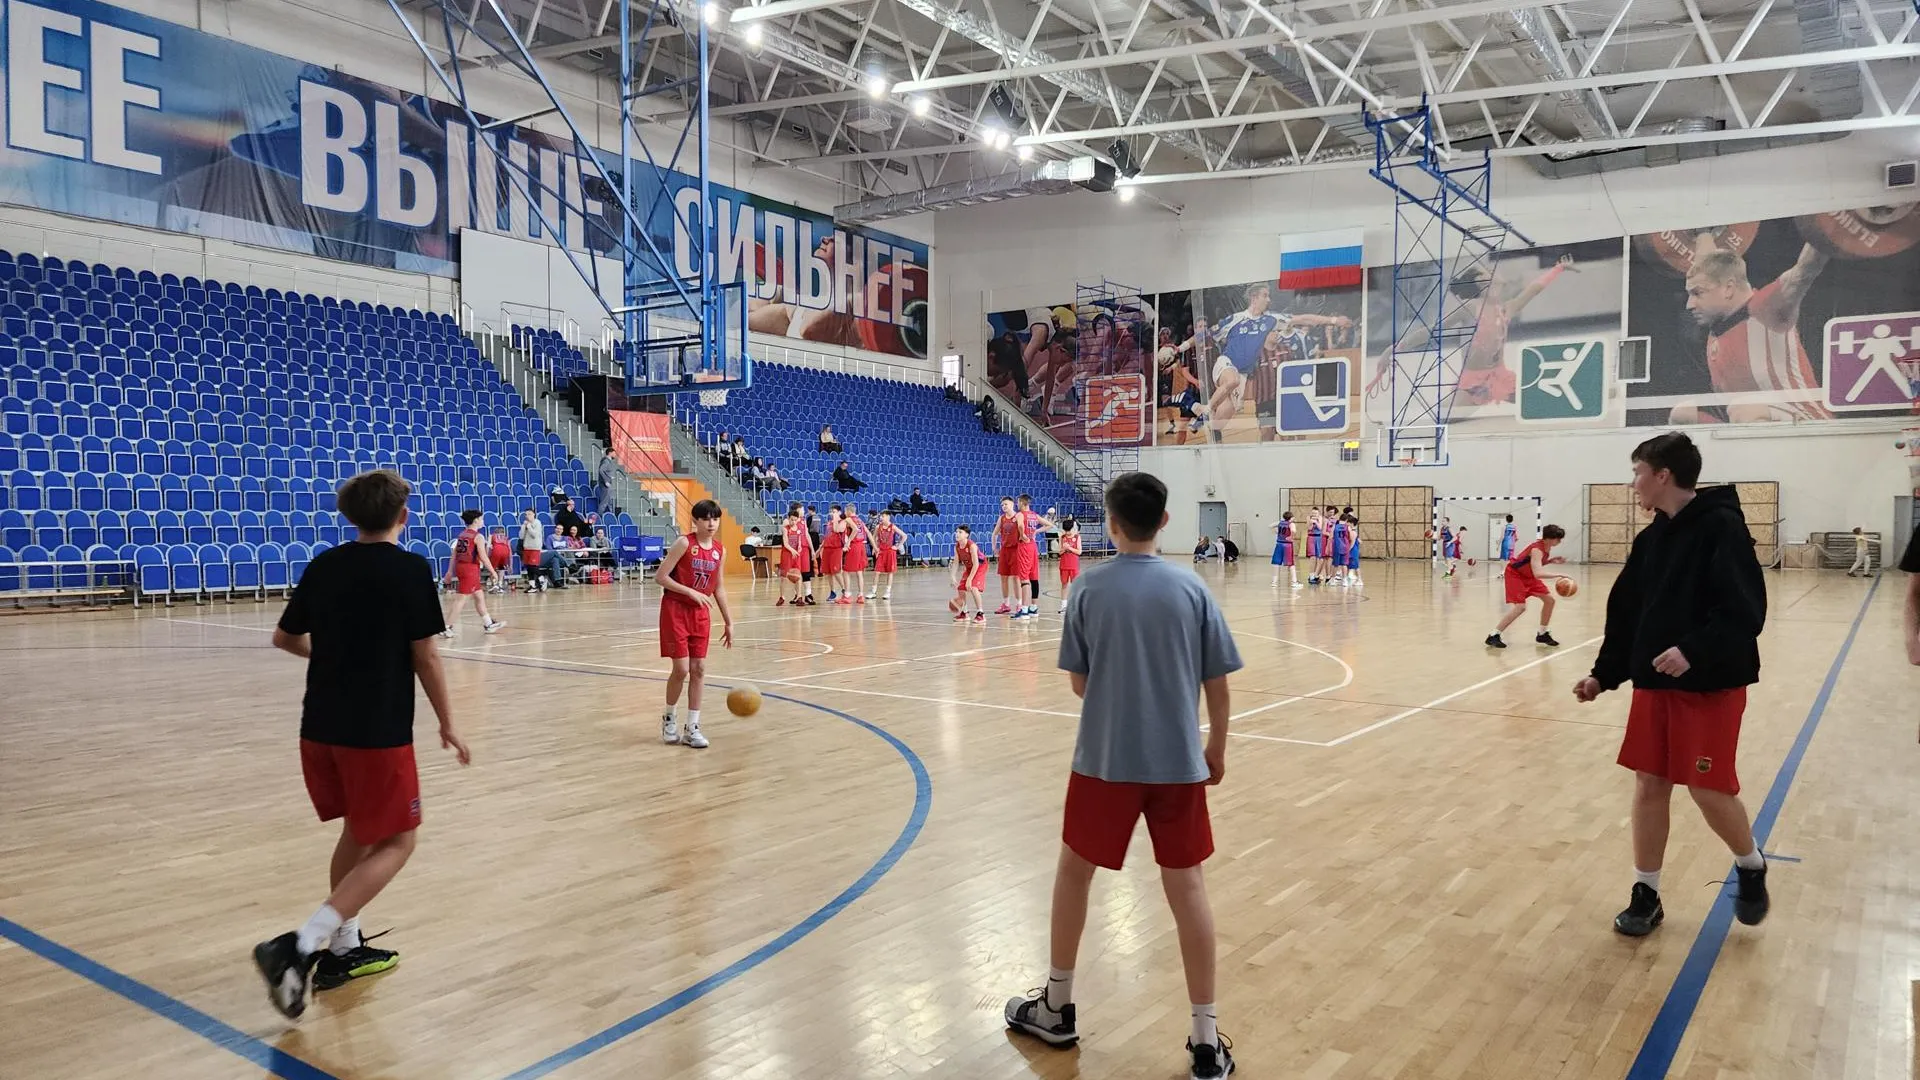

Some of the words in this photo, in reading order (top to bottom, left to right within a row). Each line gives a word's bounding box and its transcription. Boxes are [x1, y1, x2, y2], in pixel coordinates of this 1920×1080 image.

[299, 79, 606, 257] ВЫШЕ
[673, 186, 916, 328] СИЛЬНЕЕ
[1661, 230, 1696, 266] LEIKO
[1727, 231, 1744, 247] 25
[692, 571, 711, 590] 77
